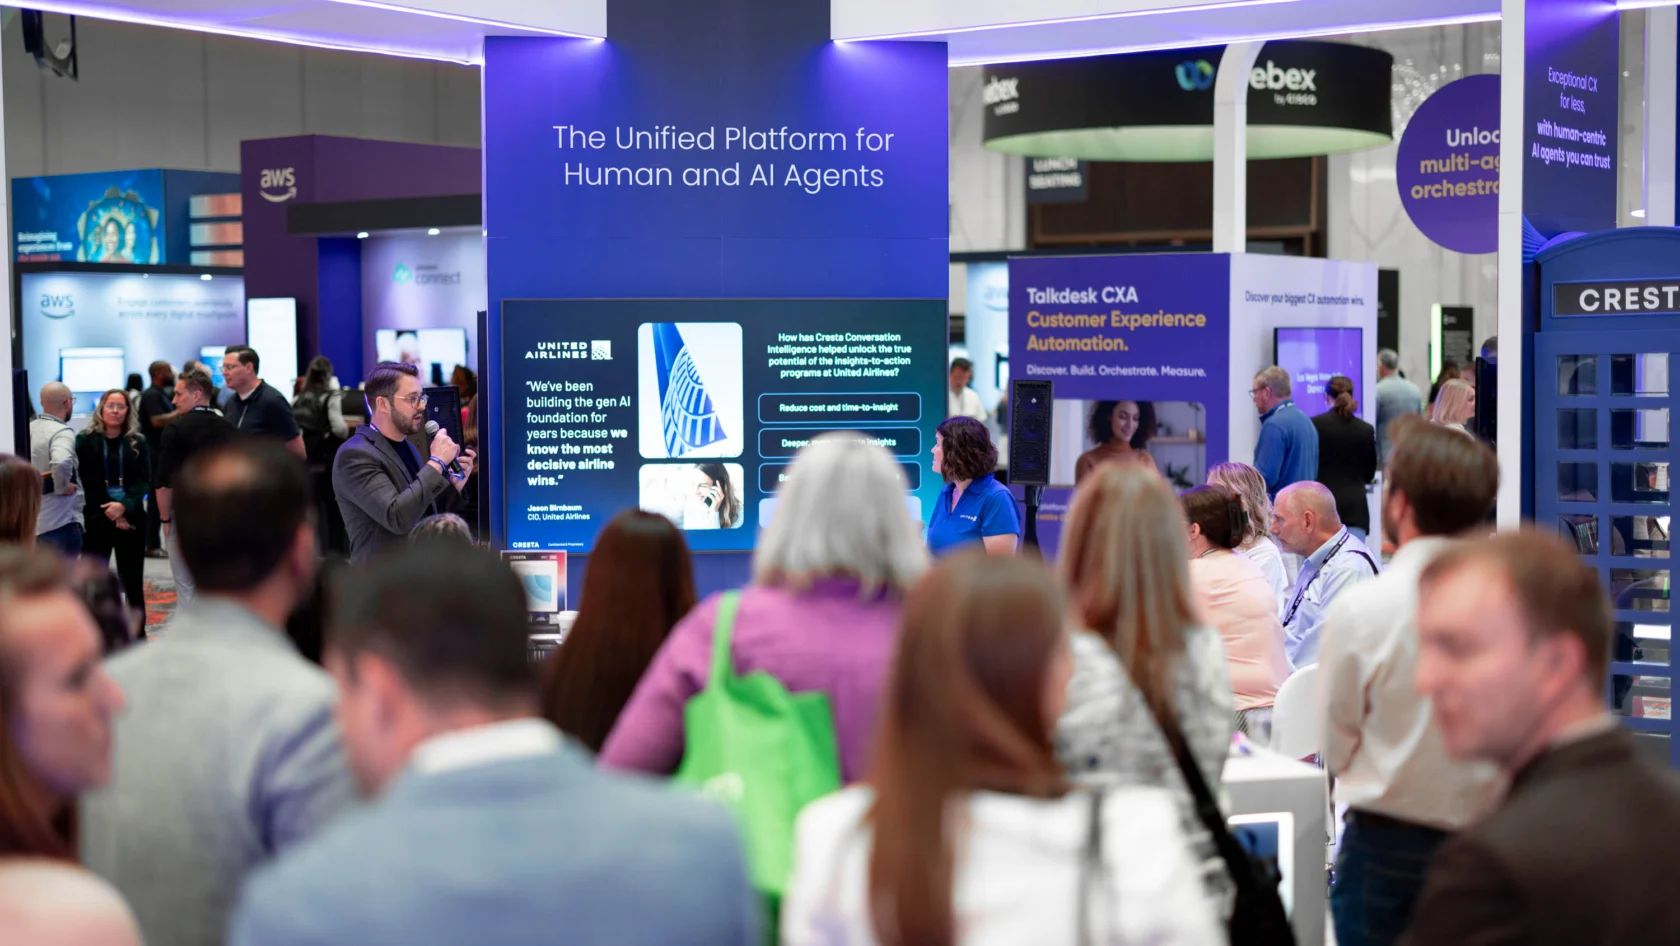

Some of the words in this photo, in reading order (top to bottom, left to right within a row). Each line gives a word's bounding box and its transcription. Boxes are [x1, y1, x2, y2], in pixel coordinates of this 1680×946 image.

[1250, 60, 1316, 91] ebex
[1548, 67, 1587, 90] Exceptional
[1588, 76, 1598, 92] CX
[983, 76, 1019, 105] ebex
[1560, 92, 1570, 109] for
[1571, 94, 1586, 116] less,
[553, 125, 606, 149] The
[616, 126, 715, 150] Unified
[725, 126, 847, 151] Platform
[856, 127, 894, 151] for
[1447, 126, 1500, 147] Unloc
[1537, 118, 1552, 137] with
[1554, 122, 1606, 146] human-centric
[1532, 143, 1540, 158] AI
[1541, 146, 1564, 165] agents
[1566, 150, 1579, 168] you
[1580, 154, 1593, 166] can
[1594, 153, 1610, 169] trust
[565, 162, 672, 186] Human
[682, 162, 740, 186] and
[750, 164, 774, 186] AI
[784, 164, 884, 194] Agents
[1027, 287, 1098, 304] Talkdesk
[1102, 286, 1138, 303] CXA
[1246, 290, 1270, 302] Discover
[1271, 294, 1283, 305] your
[1285, 293, 1306, 306] biggest
[1308, 293, 1316, 304] CX
[1317, 295, 1349, 305] automation
[1579, 286, 1680, 311] CREST
[1027, 311, 1106, 328] Customer
[1111, 309, 1206, 331] Experience
[778, 333, 798, 342] How
[799, 333, 814, 342] has
[816, 333, 844, 342] Cresta
[845, 333, 901, 342] Conversation
[1027, 334, 1128, 351] Automation.
[538, 342, 588, 350] UNITED
[768, 345, 817, 355] Intelligence
[819, 344, 847, 354] helped
[849, 344, 877, 353] unlock
[878, 344, 892, 353] the
[894, 345, 912, 353] true
[525, 351, 588, 359] AIRLINES
[768, 357, 806, 367] potential
[808, 356, 818, 366] of
[819, 356, 833, 366] the
[835, 356, 910, 366] insights-to-action
[780, 369, 821, 379] programs
[823, 368, 832, 376] at
[834, 368, 861, 376] United
[863, 368, 899, 376] Airlines?
[1027, 364, 1068, 376] Discover.
[1070, 364, 1097, 376] Build.
[1099, 365, 1158, 376] Orchestrate.
[1161, 366, 1206, 377] Measure.
[565, 381, 593, 392] been
[526, 396, 572, 410] building
[574, 396, 593, 407] the
[596, 398, 616, 410] gen
[619, 396, 631, 407] AI
[780, 404, 808, 412] Reduce
[809, 404, 826, 412] cost
[827, 404, 841, 412] and
[842, 404, 898, 412] time-to-insight
[526, 412, 588, 423] foundation
[590, 412, 607, 422] for
[527, 430, 558, 441] years
[560, 428, 608, 438] because
[610, 429, 628, 438] we
[527, 444, 558, 454] know
[561, 443, 580, 454] the
[583, 444, 613, 454] most
[782, 439, 810, 448] Deeper,
[867, 438, 896, 448] insights
[527, 459, 576, 470] decisive
[578, 458, 614, 470] airline
[527, 504, 548, 512] Jason
[550, 504, 582, 512] Birnbaum
[566, 512, 590, 520] Airlines
